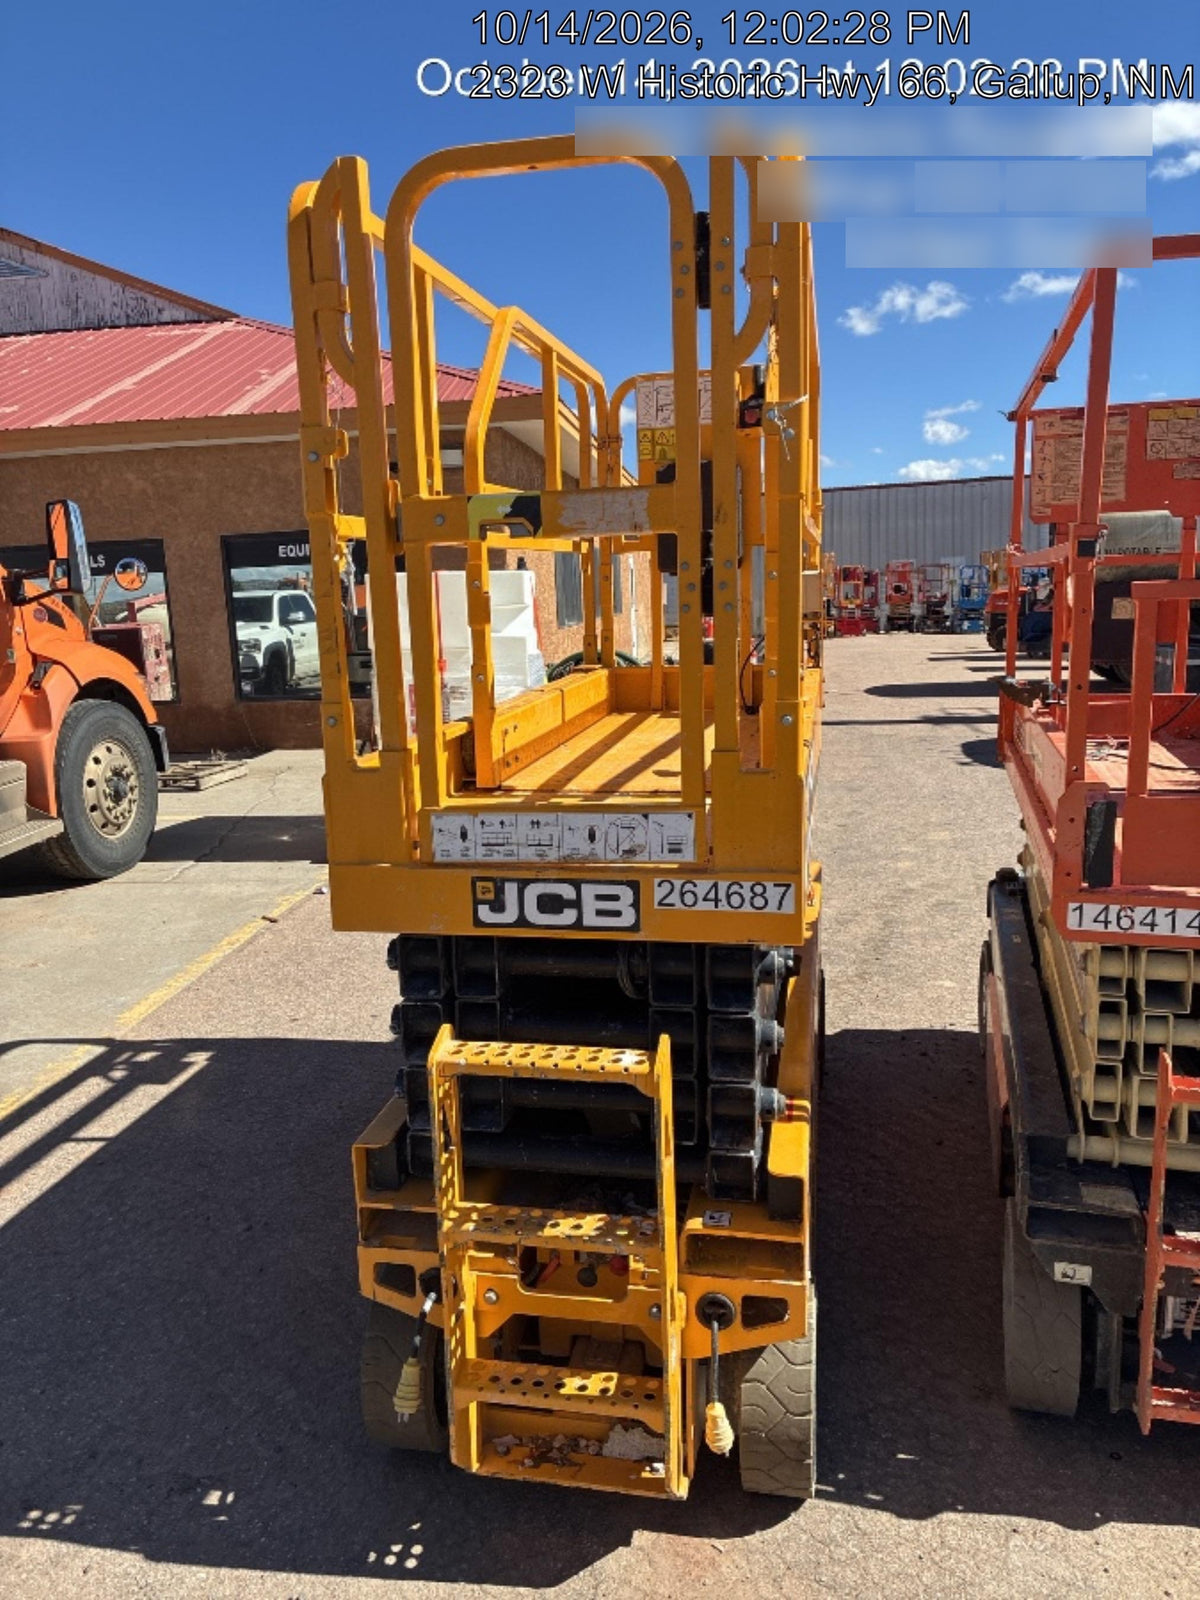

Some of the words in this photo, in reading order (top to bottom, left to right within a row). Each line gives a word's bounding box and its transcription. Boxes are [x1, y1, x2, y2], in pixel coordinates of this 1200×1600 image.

[477, 881, 638, 928] JCB
[656, 879, 793, 911] 264687
[1071, 902, 1200, 935] 146414
